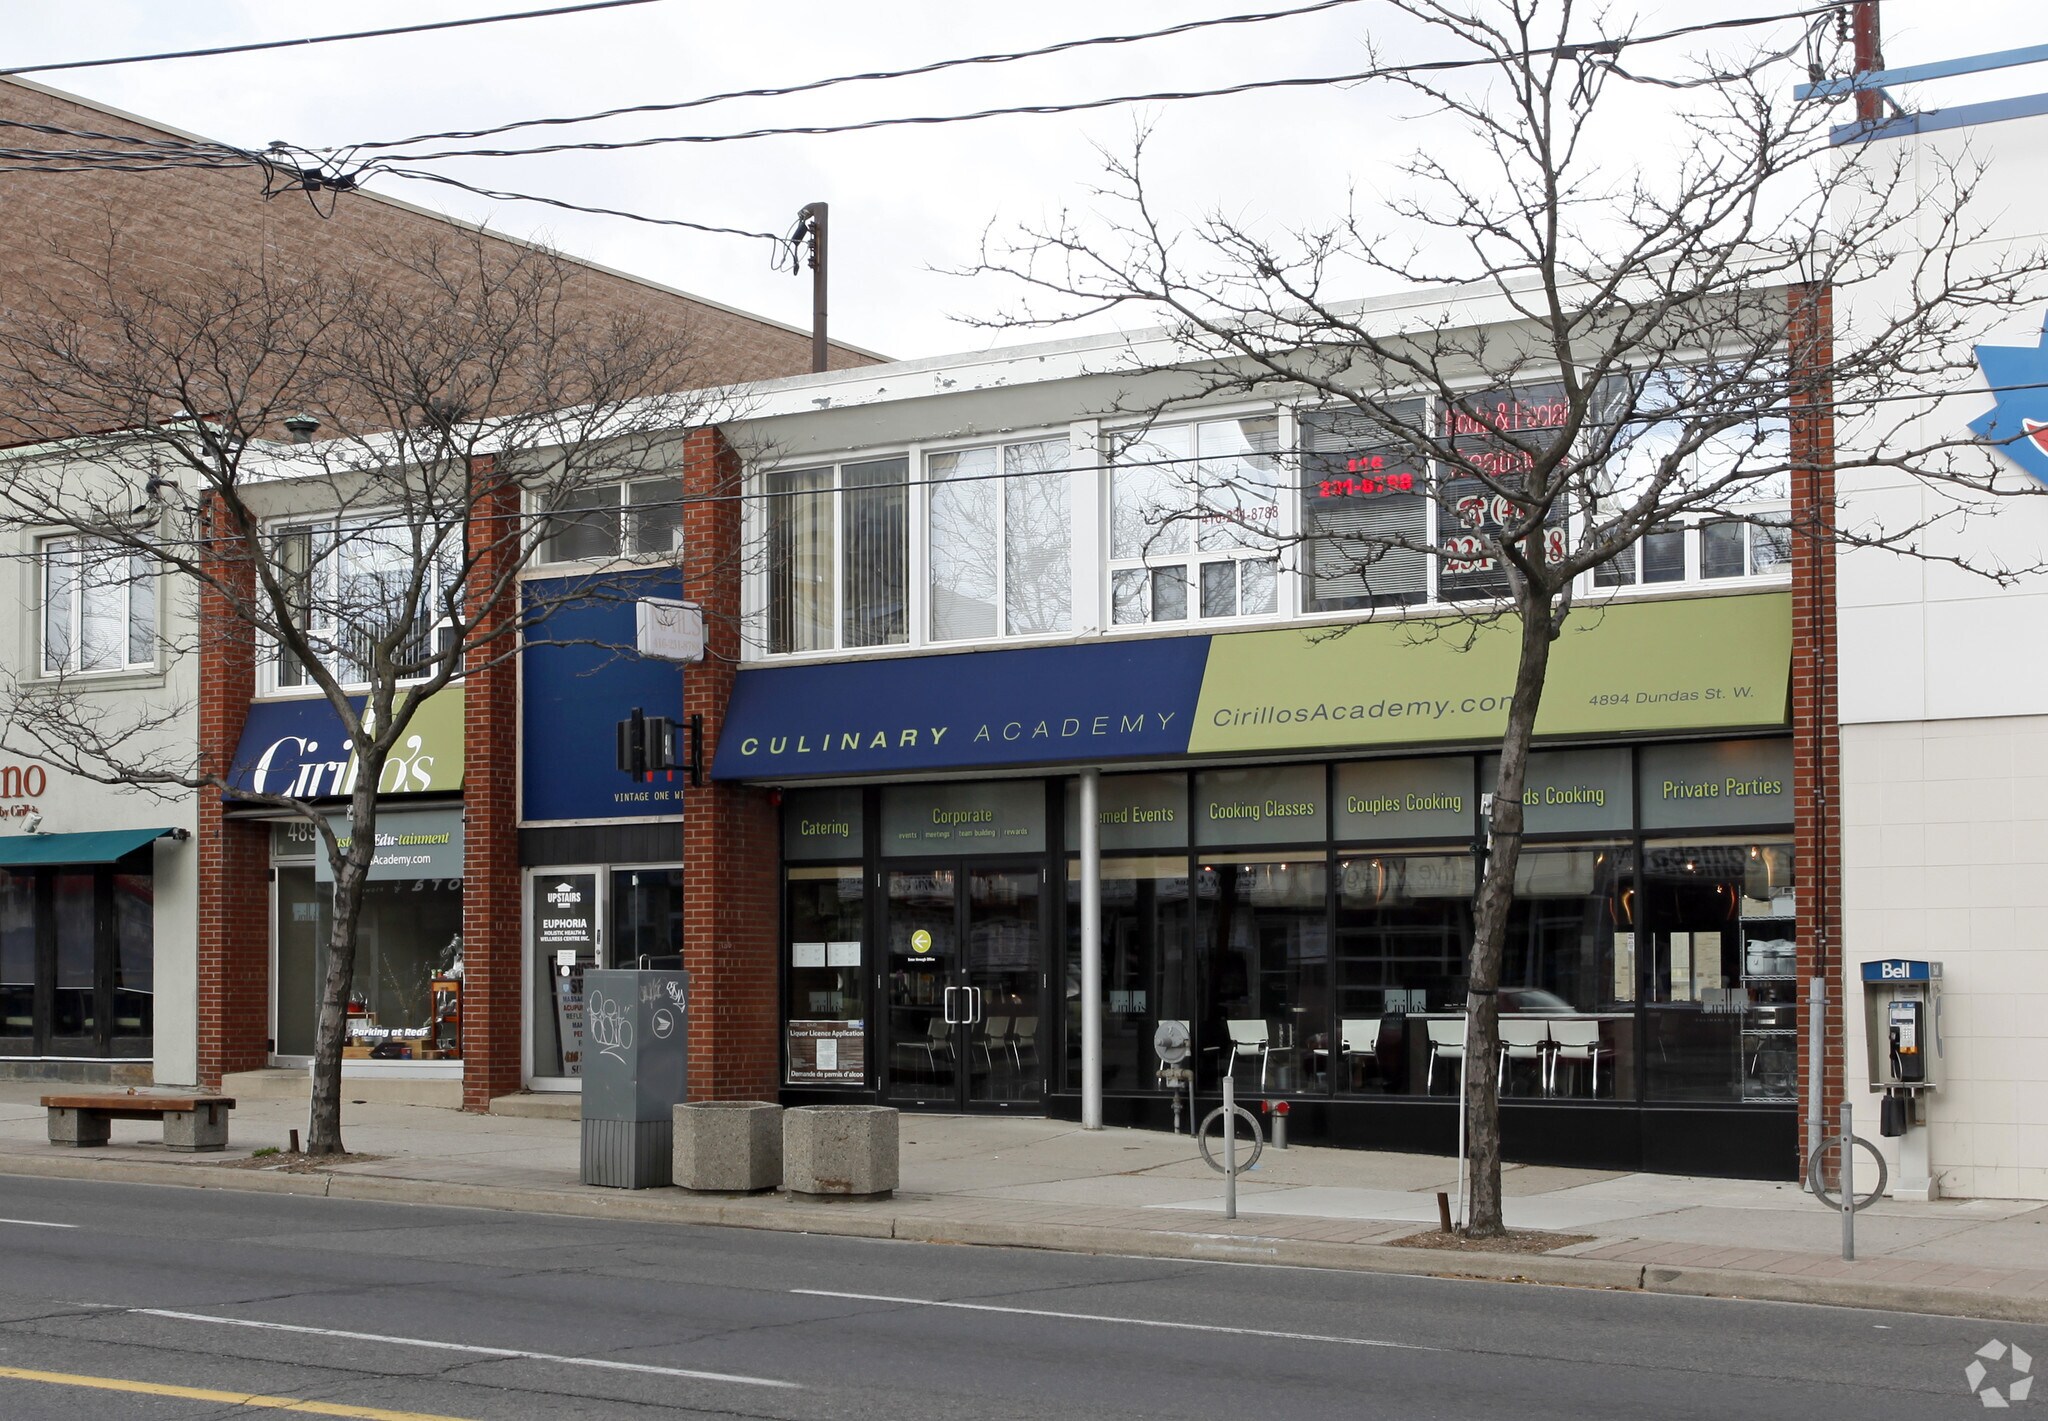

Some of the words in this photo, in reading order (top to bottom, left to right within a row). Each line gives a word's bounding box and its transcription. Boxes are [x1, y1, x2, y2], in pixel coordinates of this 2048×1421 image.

[1589, 693, 1630, 706] 4894
[1636, 690, 1699, 704] Dundas
[1704, 688, 1726, 700] St.
[1733, 686, 1754, 698] W.
[740, 726, 948, 756] CULINARY
[973, 711, 1176, 744] ACADEMY
[614, 791, 649, 802] VINTAGE
[654, 791, 669, 800] ONE
[1545, 785, 1604, 807] Cooking
[1663, 780, 1719, 799] Private
[1725, 777, 1781, 796] Parties
[1209, 801, 1260, 821] Cooking
[1265, 800, 1314, 817] Classes
[1347, 795, 1400, 816] Couples
[1406, 792, 1461, 813] Cooking
[932, 808, 992, 826] Corporate
[1133, 806, 1174, 823] Events
[801, 819, 849, 837] Catering
[898, 831, 917, 839] events
[925, 830, 950, 839] meetings
[958, 830, 973, 838] team
[974, 828, 996, 838] building
[1004, 827, 1028, 836] rewards
[547, 892, 581, 903] UPSTAIRS
[543, 918, 587, 929] EUPHORIA
[1882, 962, 1910, 978] Bell
[352, 1027, 389, 1037] Parking
[391, 1028, 402, 1036] at
[404, 1027, 427, 1036] Rear
[789, 1029, 808, 1038] Liquor
[809, 1029, 831, 1037] Licence
[831, 1029, 864, 1038] Application
[824, 1070, 843, 1078] permis
